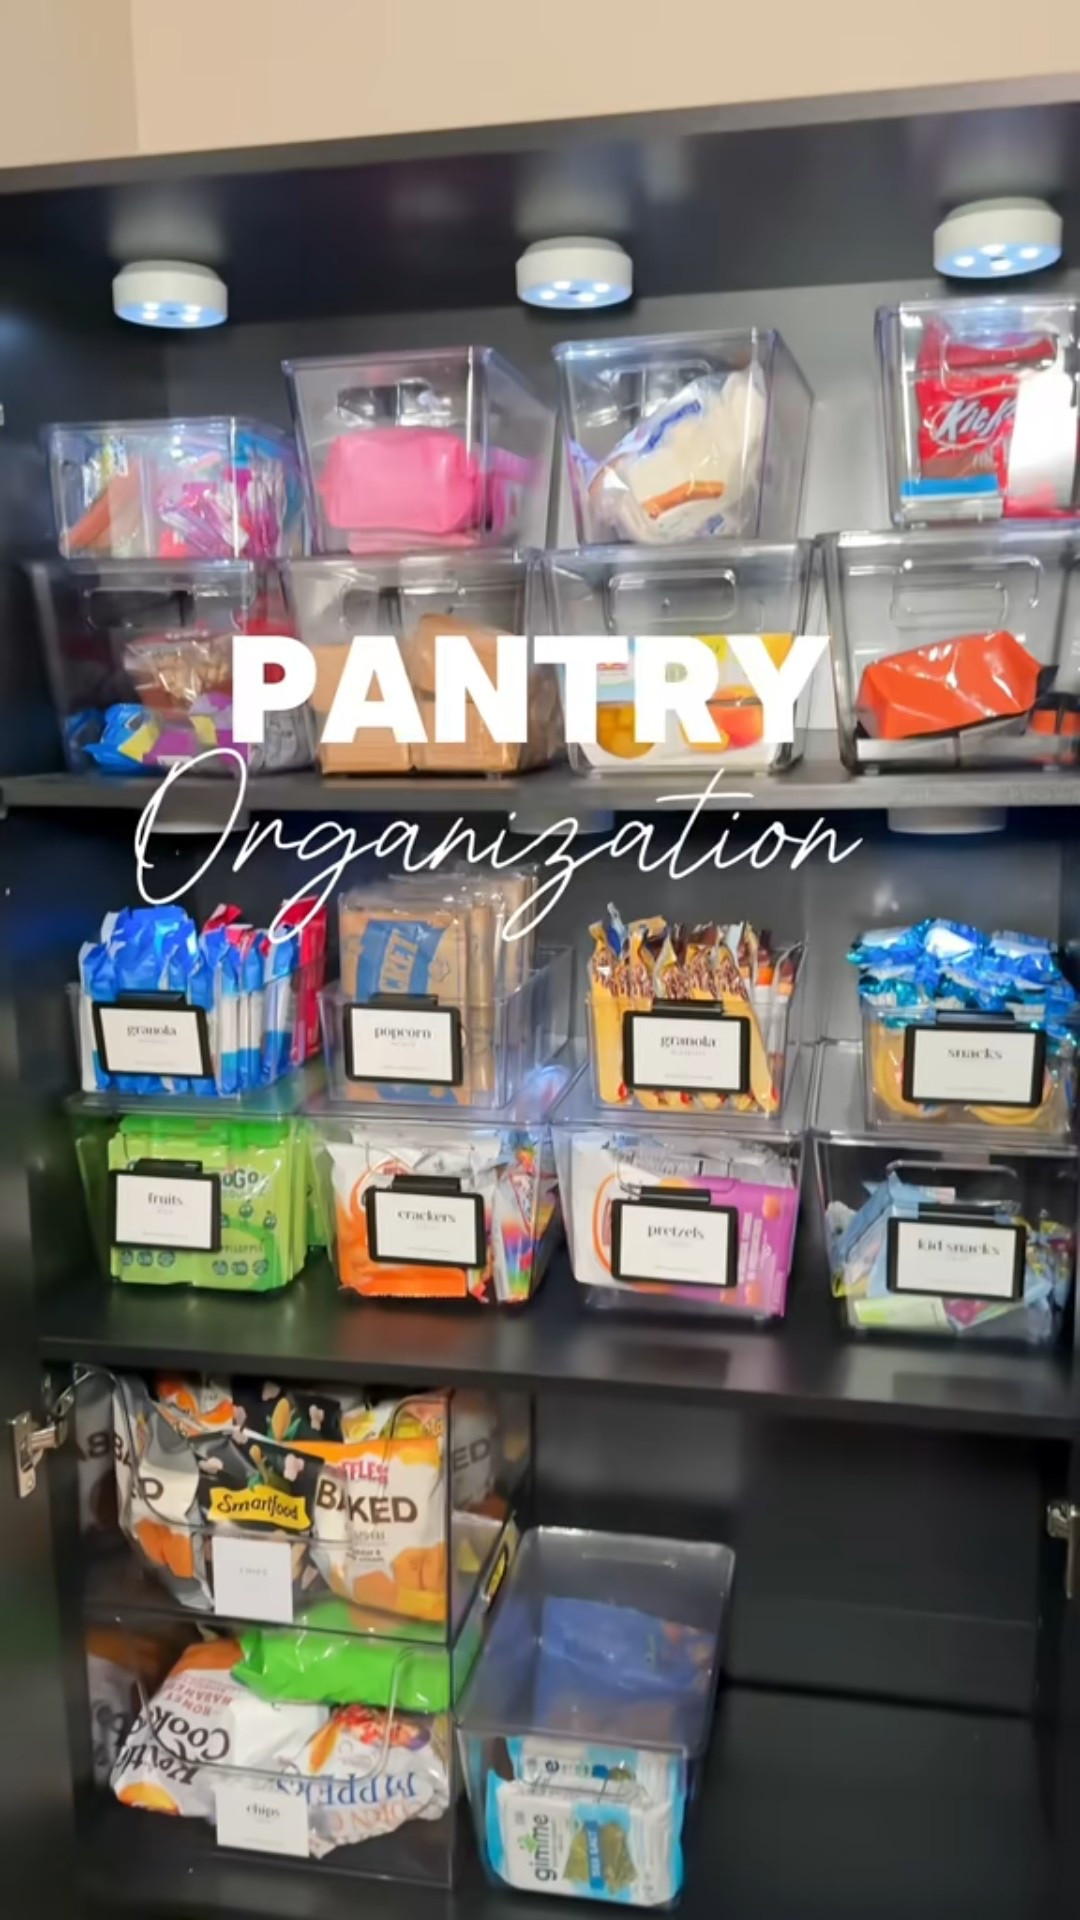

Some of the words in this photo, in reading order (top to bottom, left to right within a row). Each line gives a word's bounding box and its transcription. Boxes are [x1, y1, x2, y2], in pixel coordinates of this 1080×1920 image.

[127, 1024, 177, 1037] granola
[374, 1026, 432, 1040] popcorn
[661, 1035, 716, 1048] granola
[948, 1047, 1003, 1060] snacks
[223, 1168, 259, 1189] oGo
[147, 1191, 183, 1206] fruits
[397, 1209, 457, 1224] crackers
[647, 1224, 705, 1240] pretzels
[917, 1238, 943, 1252] kid
[946, 1242, 1001, 1256] snacks
[216, 1494, 300, 1521] Smartfood
[246, 1804, 281, 1818] chips
[530, 1814, 557, 1882] gimme
